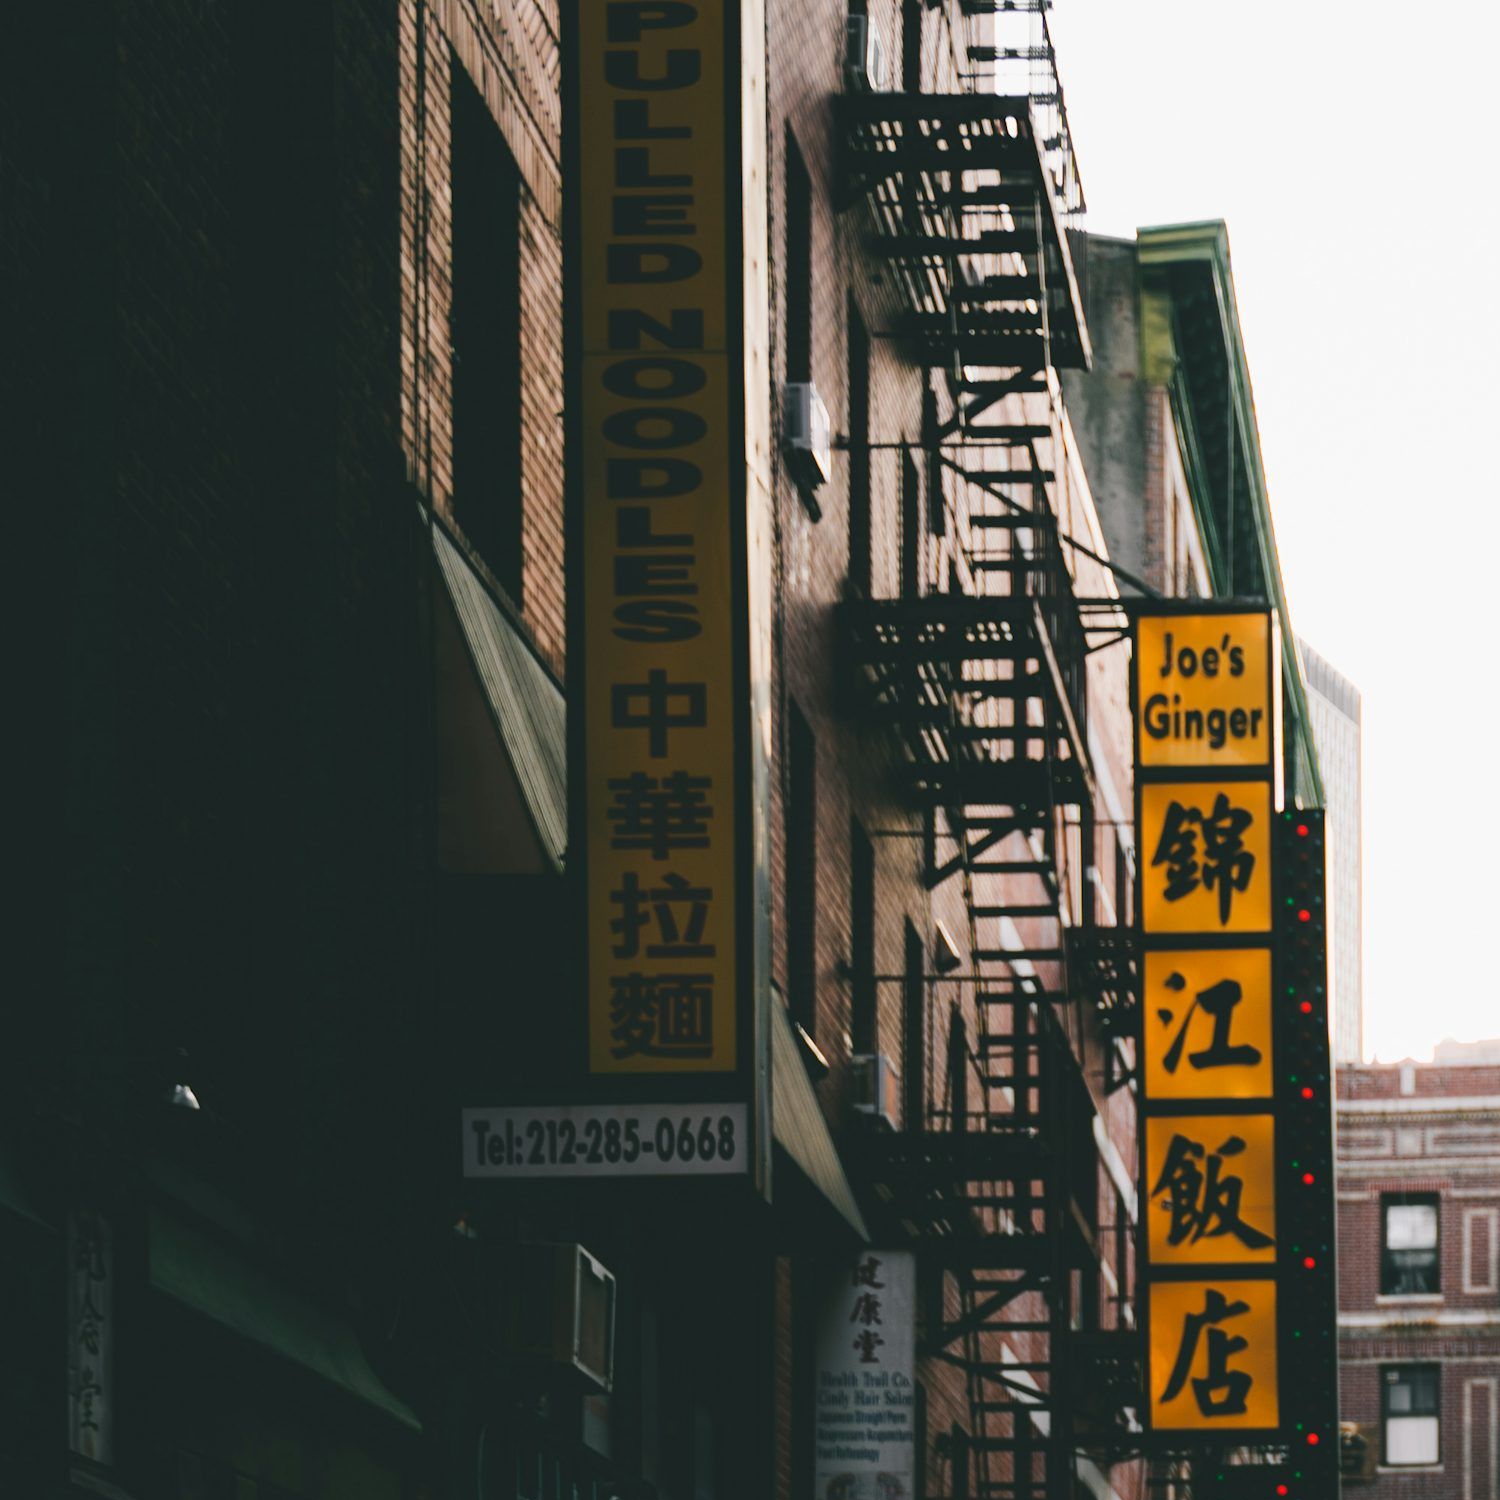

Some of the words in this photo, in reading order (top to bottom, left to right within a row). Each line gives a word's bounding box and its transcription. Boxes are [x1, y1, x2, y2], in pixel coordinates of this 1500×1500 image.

[603, 1, 703, 285] PULLED
[601, 308, 708, 644] NOODLES
[1143, 693, 1264, 749] Ginger
[1159, 631, 1245, 679] Joe's
[606, 668, 716, 1061] 中華拉麵
[1150, 792, 1277, 1419] 錦江飯店
[849, 1256, 886, 1365] 健康堂
